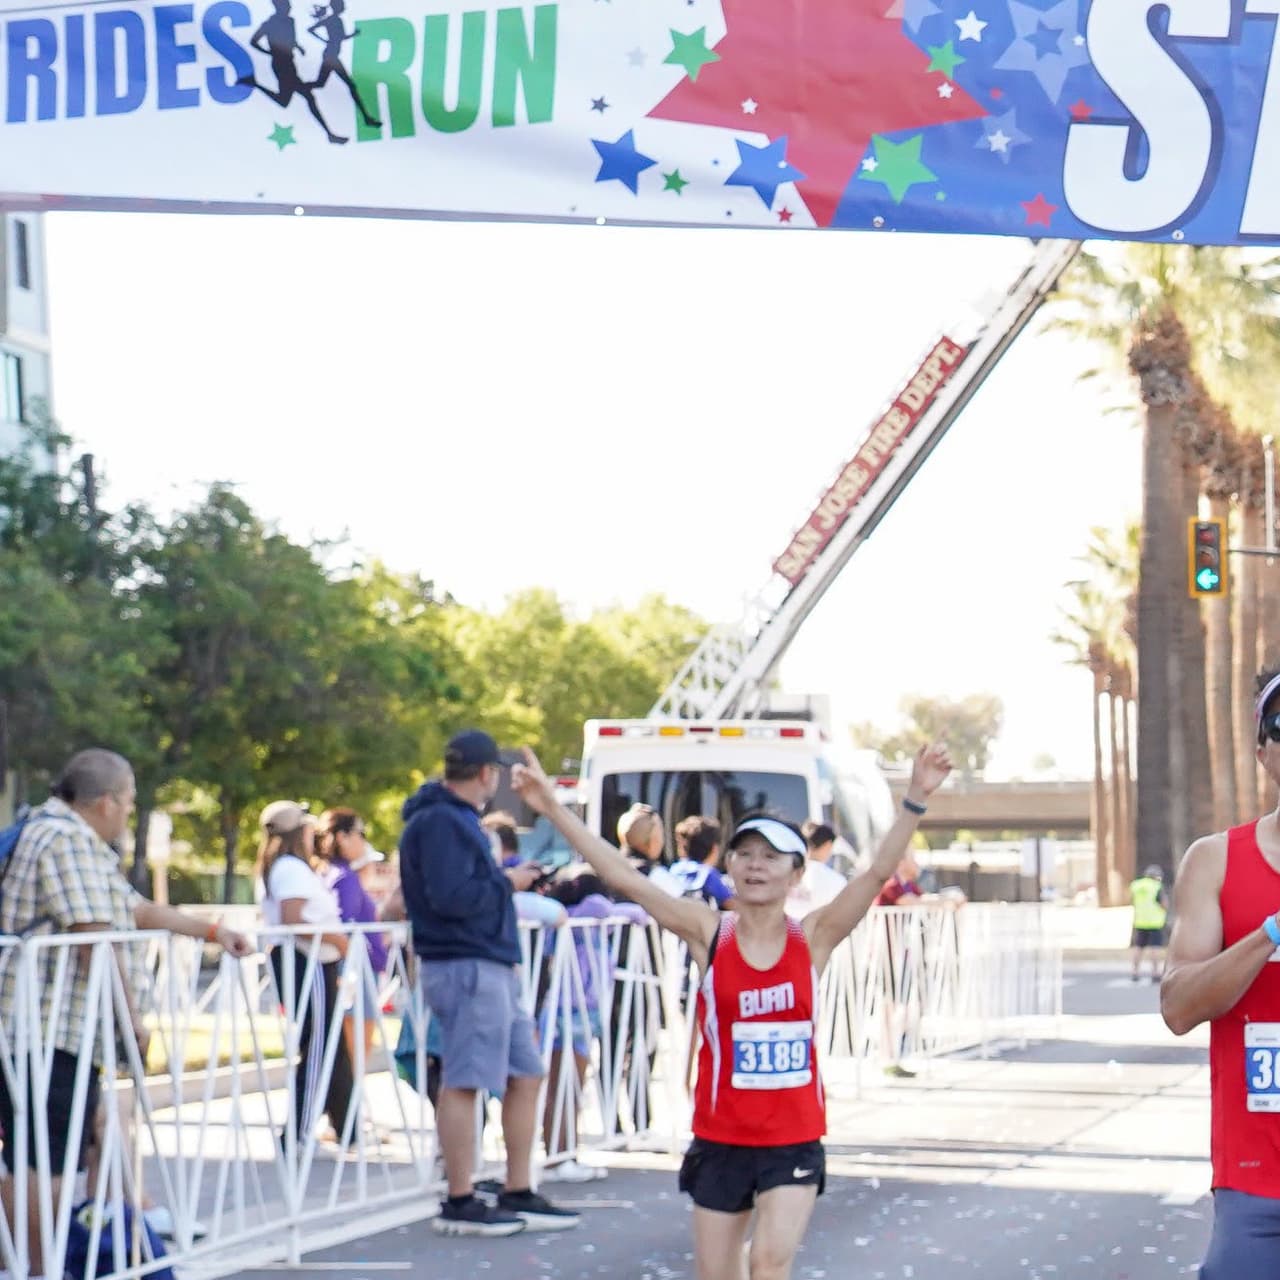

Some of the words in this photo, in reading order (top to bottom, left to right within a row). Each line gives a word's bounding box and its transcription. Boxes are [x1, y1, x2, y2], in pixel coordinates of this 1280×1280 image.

[6, 1, 256, 123] RIDES
[354, 4, 559, 142] RUN
[776, 526, 822, 578] SAN
[815, 461, 869, 529] JOSE
[858, 406, 910, 468] FIRE
[739, 1041, 806, 1072] 3189
